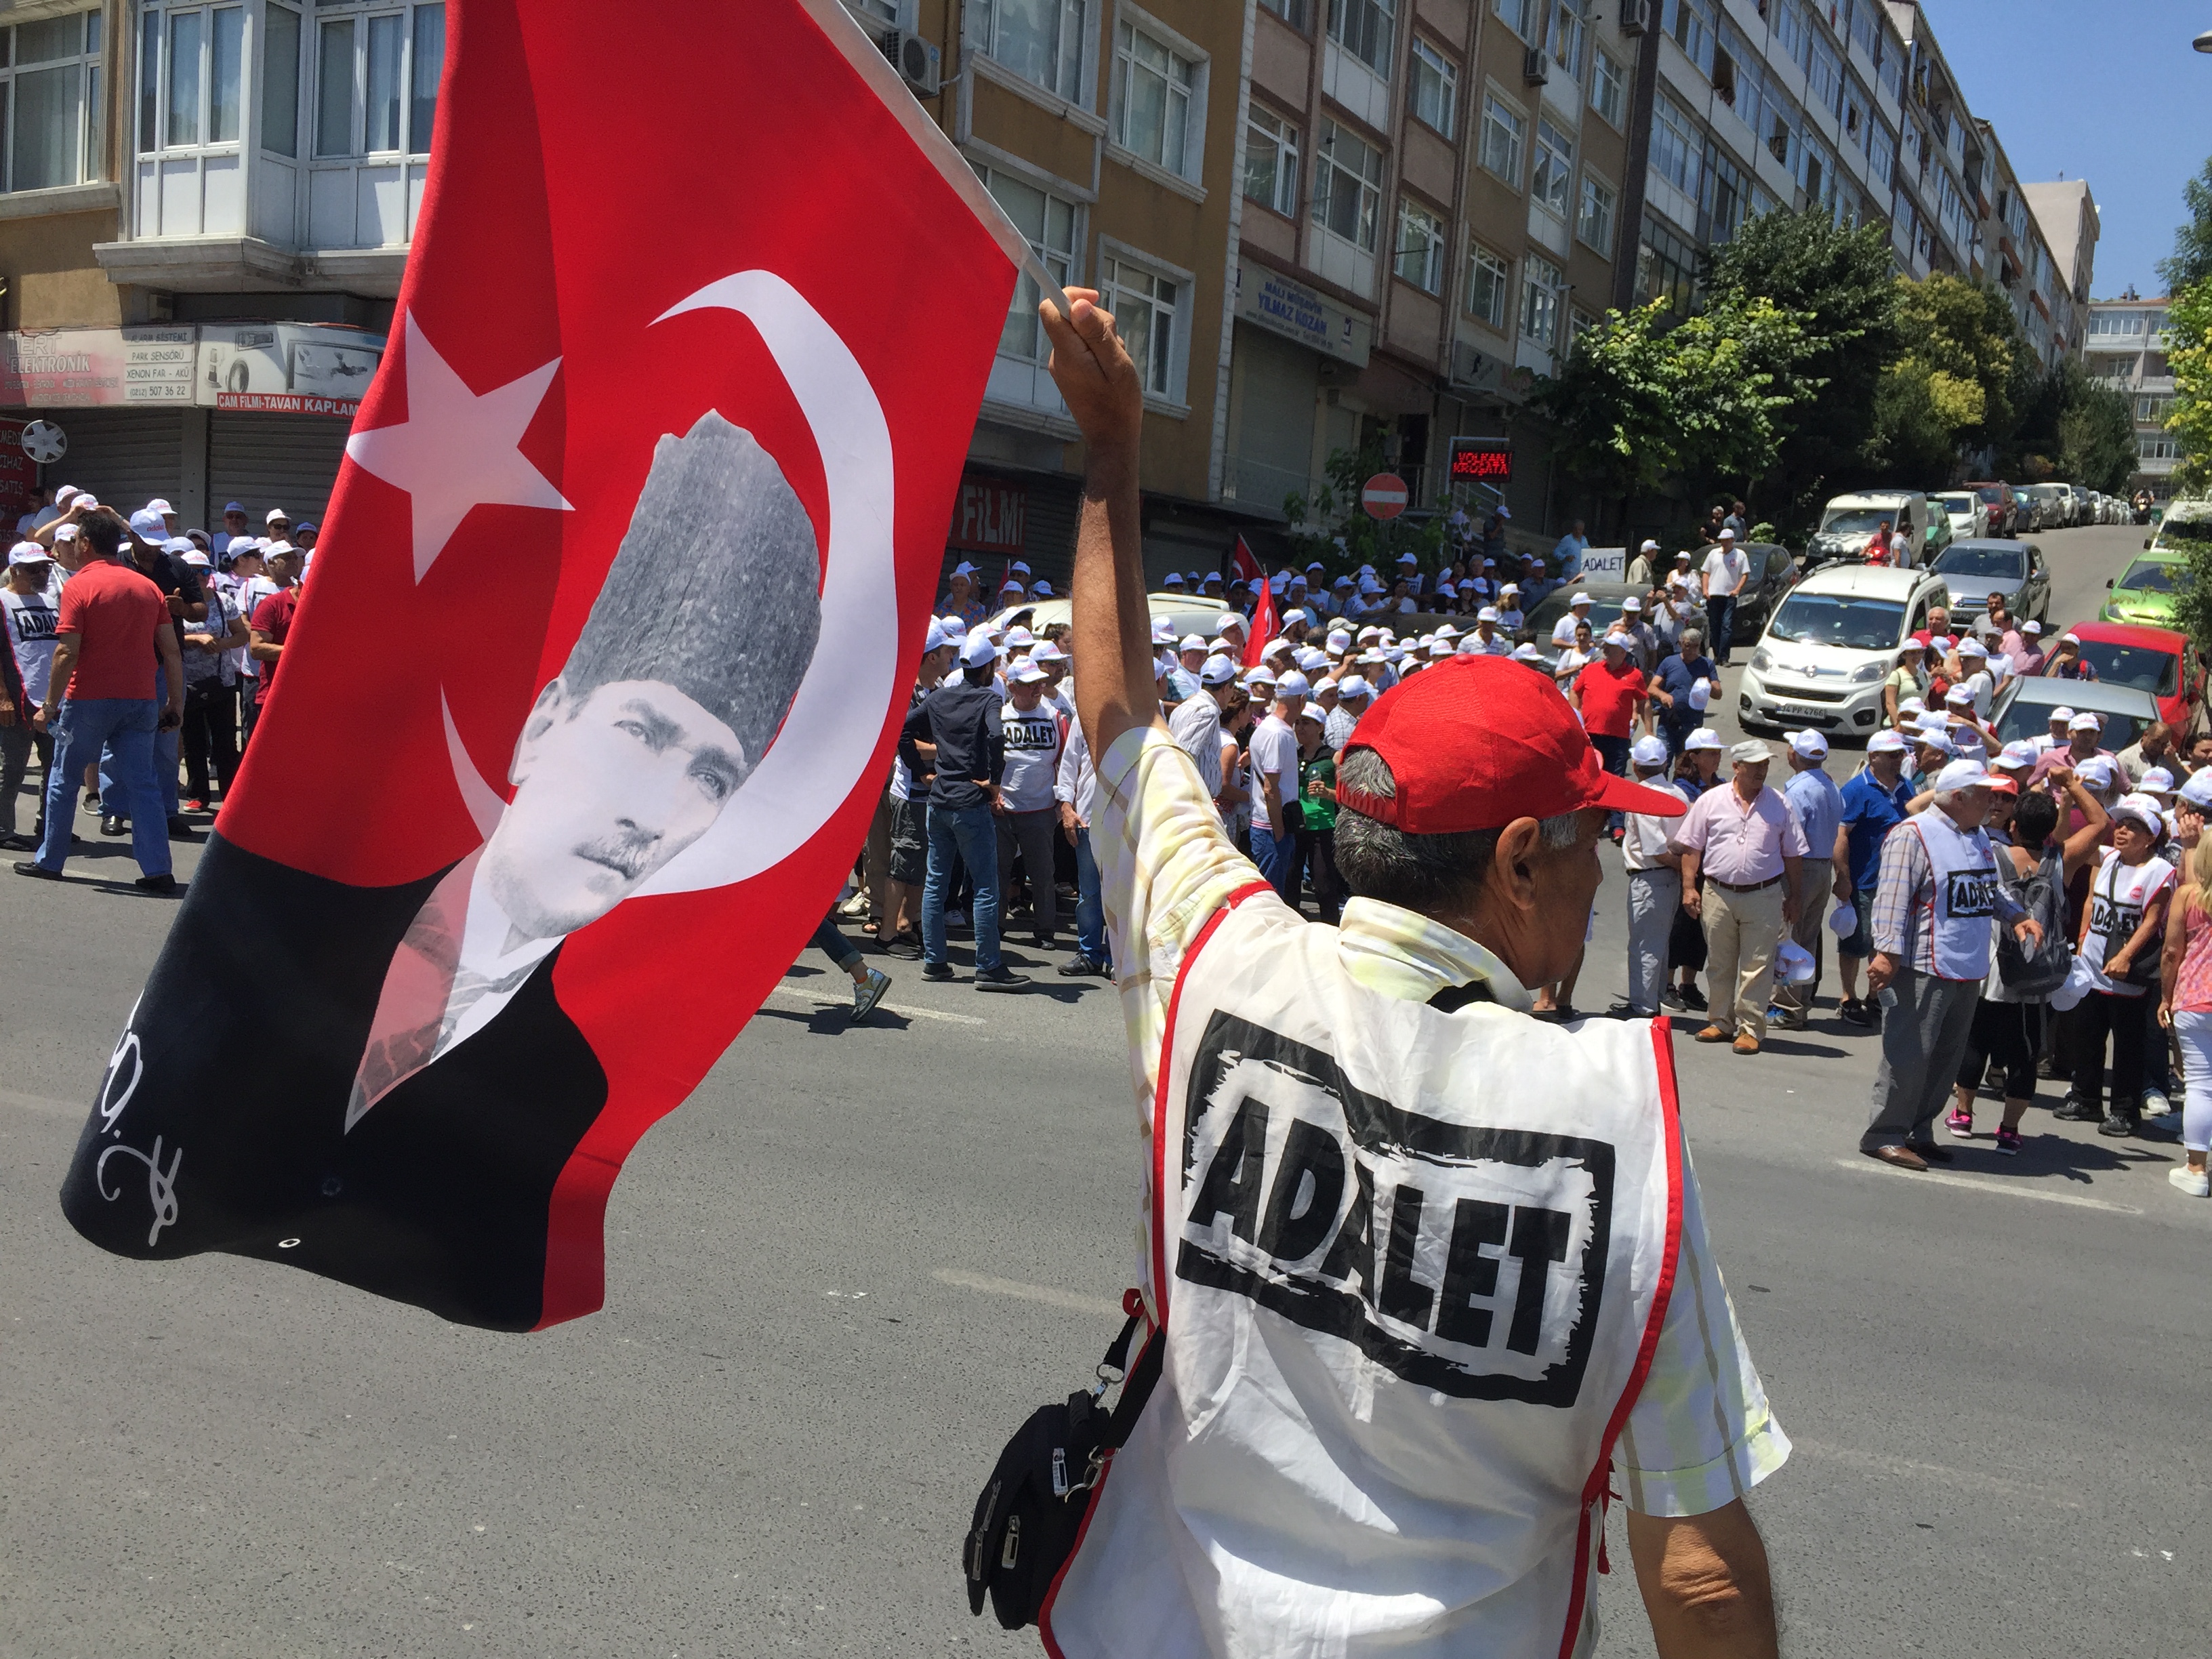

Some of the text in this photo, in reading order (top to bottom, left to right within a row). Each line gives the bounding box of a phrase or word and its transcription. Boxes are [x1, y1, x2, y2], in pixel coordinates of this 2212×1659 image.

[131, 349, 184, 361] PARK SENSÖRÜ
[126, 369, 150, 378] XENON
[152, 369, 166, 378] FAR
[175, 367, 189, 377] AKÜ
[129, 386, 186, 398] (0212) 507 36 22
[218, 394, 237, 408] CAM
[305, 399, 359, 417] KAPLAM
[1582, 556, 1624, 571] ADALET
[23, 613, 58, 634] ADAL
[1006, 726, 1054, 744] ADALET
[1187, 1095, 1572, 1356] ADALET
